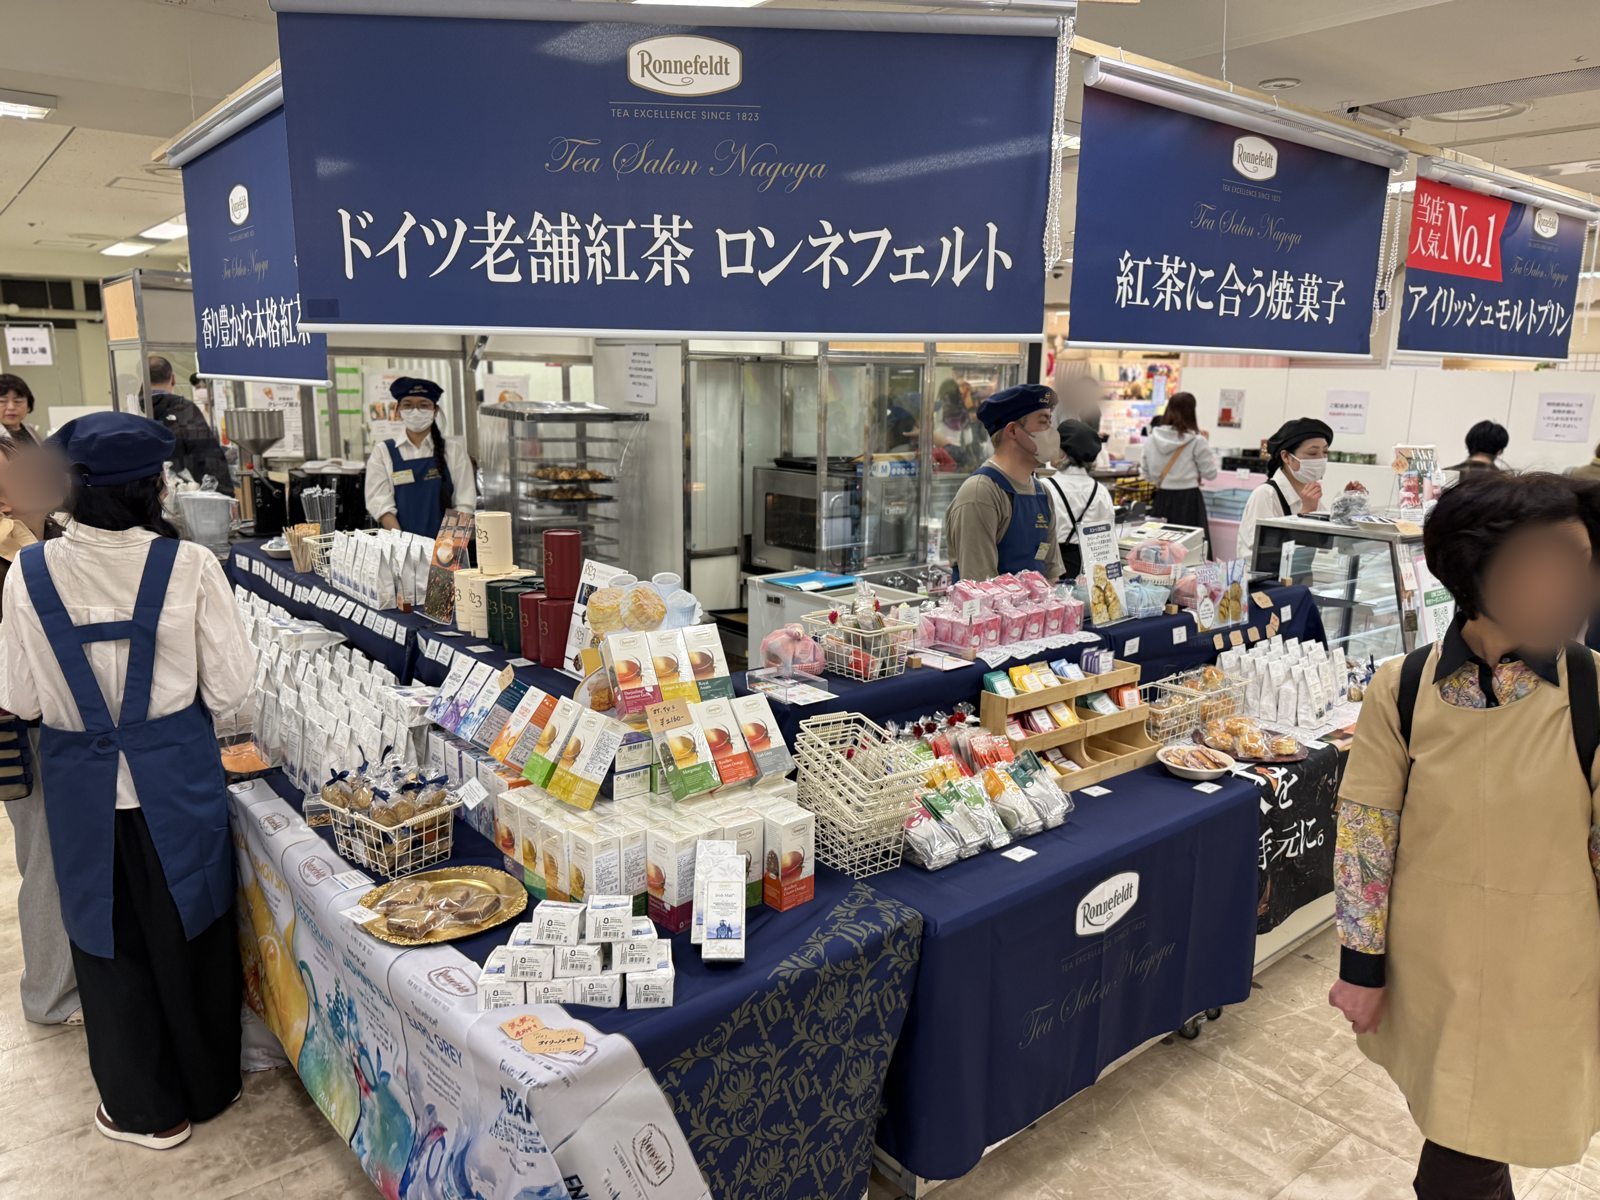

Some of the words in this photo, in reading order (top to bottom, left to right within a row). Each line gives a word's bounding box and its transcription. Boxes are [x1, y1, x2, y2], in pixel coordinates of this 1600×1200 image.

[637, 50, 730, 86] Ronnefeldt
[611, 108, 630, 118] TEA
[634, 109, 697, 119] EXCELLENCE
[701, 111, 731, 120] SINCE
[736, 112, 759, 121] 1823
[545, 136, 602, 173] Tea
[612, 139, 702, 181] Salon
[708, 138, 829, 193] Nagoya
[1237, 143, 1275, 173] Ronnefeldt
[1190, 201, 1217, 229] Tea
[1219, 209, 1255, 237] Salon
[1257, 213, 1302, 254] Nagoya
[1416, 192, 1445, 227] 当店
[1440, 202, 1497, 268] No.1
[337, 207, 695, 287] ドイツ老舗紅茶
[716, 219, 1013, 291] ロンネフェルト
[1411, 227, 1441, 260] 人気
[1115, 249, 1346, 325] 紅茶に合う焼菓子
[1408, 284, 1572, 337] アイリッシュモルトプリン
[1081, 882, 1134, 929] Ronnefeldt
[404, 1011, 434, 1044] EARL
[434, 1034, 463, 1069] GREY
[1019, 999, 1055, 1049] Tea
